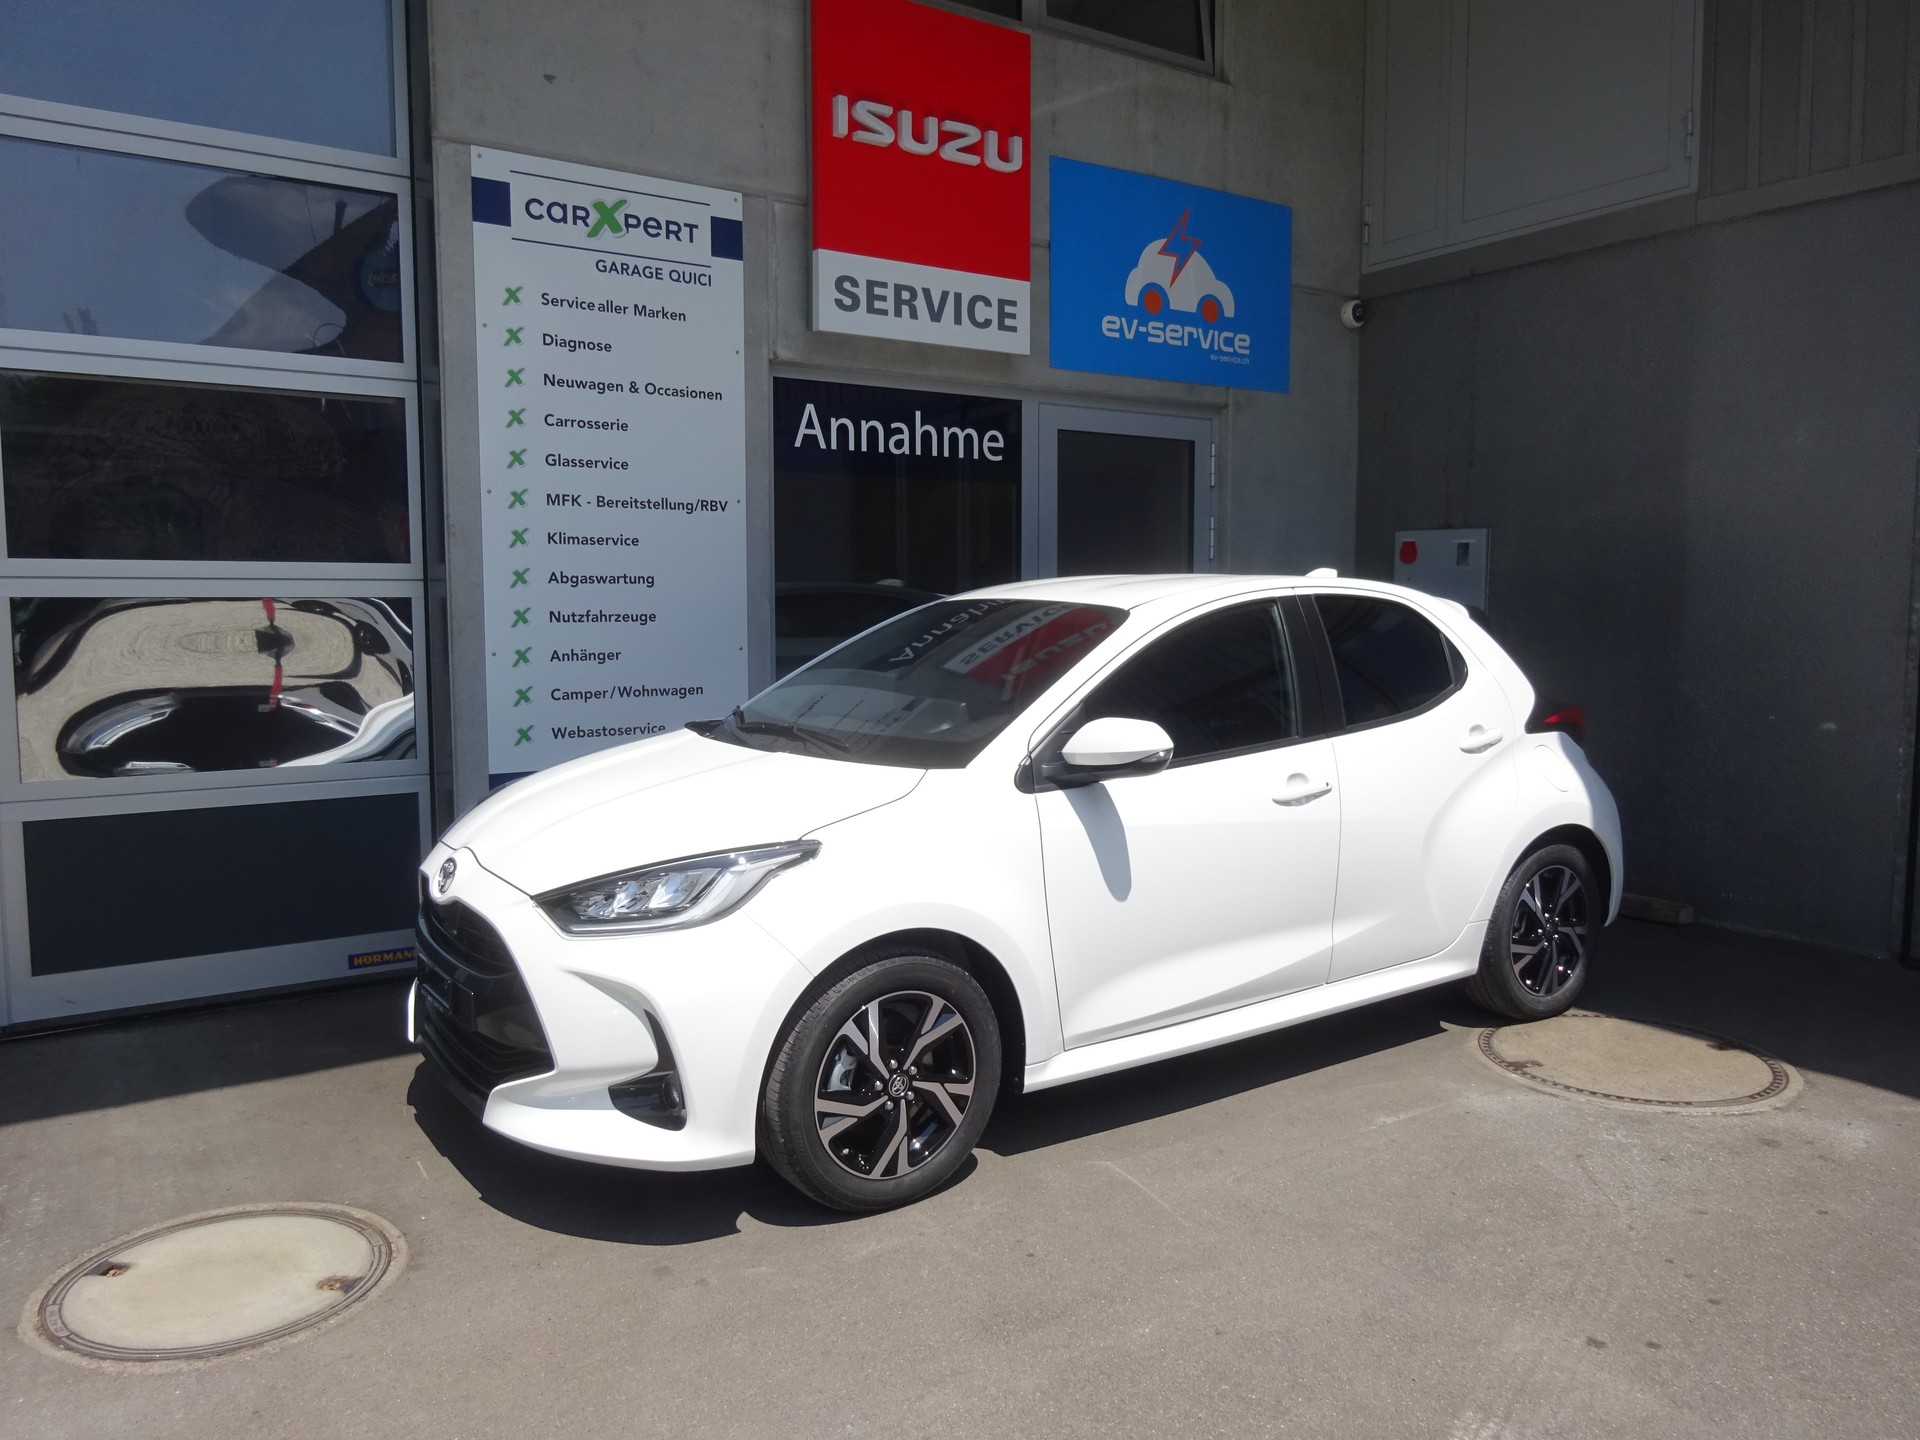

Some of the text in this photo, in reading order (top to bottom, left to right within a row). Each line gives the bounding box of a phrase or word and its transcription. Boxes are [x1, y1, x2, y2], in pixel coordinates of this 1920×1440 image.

[832, 94, 1023, 173] ISUZU
[595, 259, 712, 287] GARAGE QUICI
[541, 292, 686, 322] Service aller Marken
[834, 275, 1018, 333] SERVICE
[542, 333, 612, 353] Diagnose
[1101, 315, 1251, 355] ev-service
[1210, 354, 1250, 365] ev-service.ch
[543, 373, 723, 401] Neuwagen & Occasionen
[544, 413, 629, 432] Carrosserie
[794, 403, 1005, 462] Annahme
[545, 453, 629, 471] Glasservice
[546, 493, 582, 507] MFK
[596, 495, 728, 515] Bereitstellung/RBV
[547, 531, 640, 547] Klimaservice
[547, 570, 655, 589] Abgaswartung
[549, 609, 657, 626] Nutzfahrzeuge
[549, 648, 622, 665] Anhänger
[551, 722, 666, 740] Webastoservice
